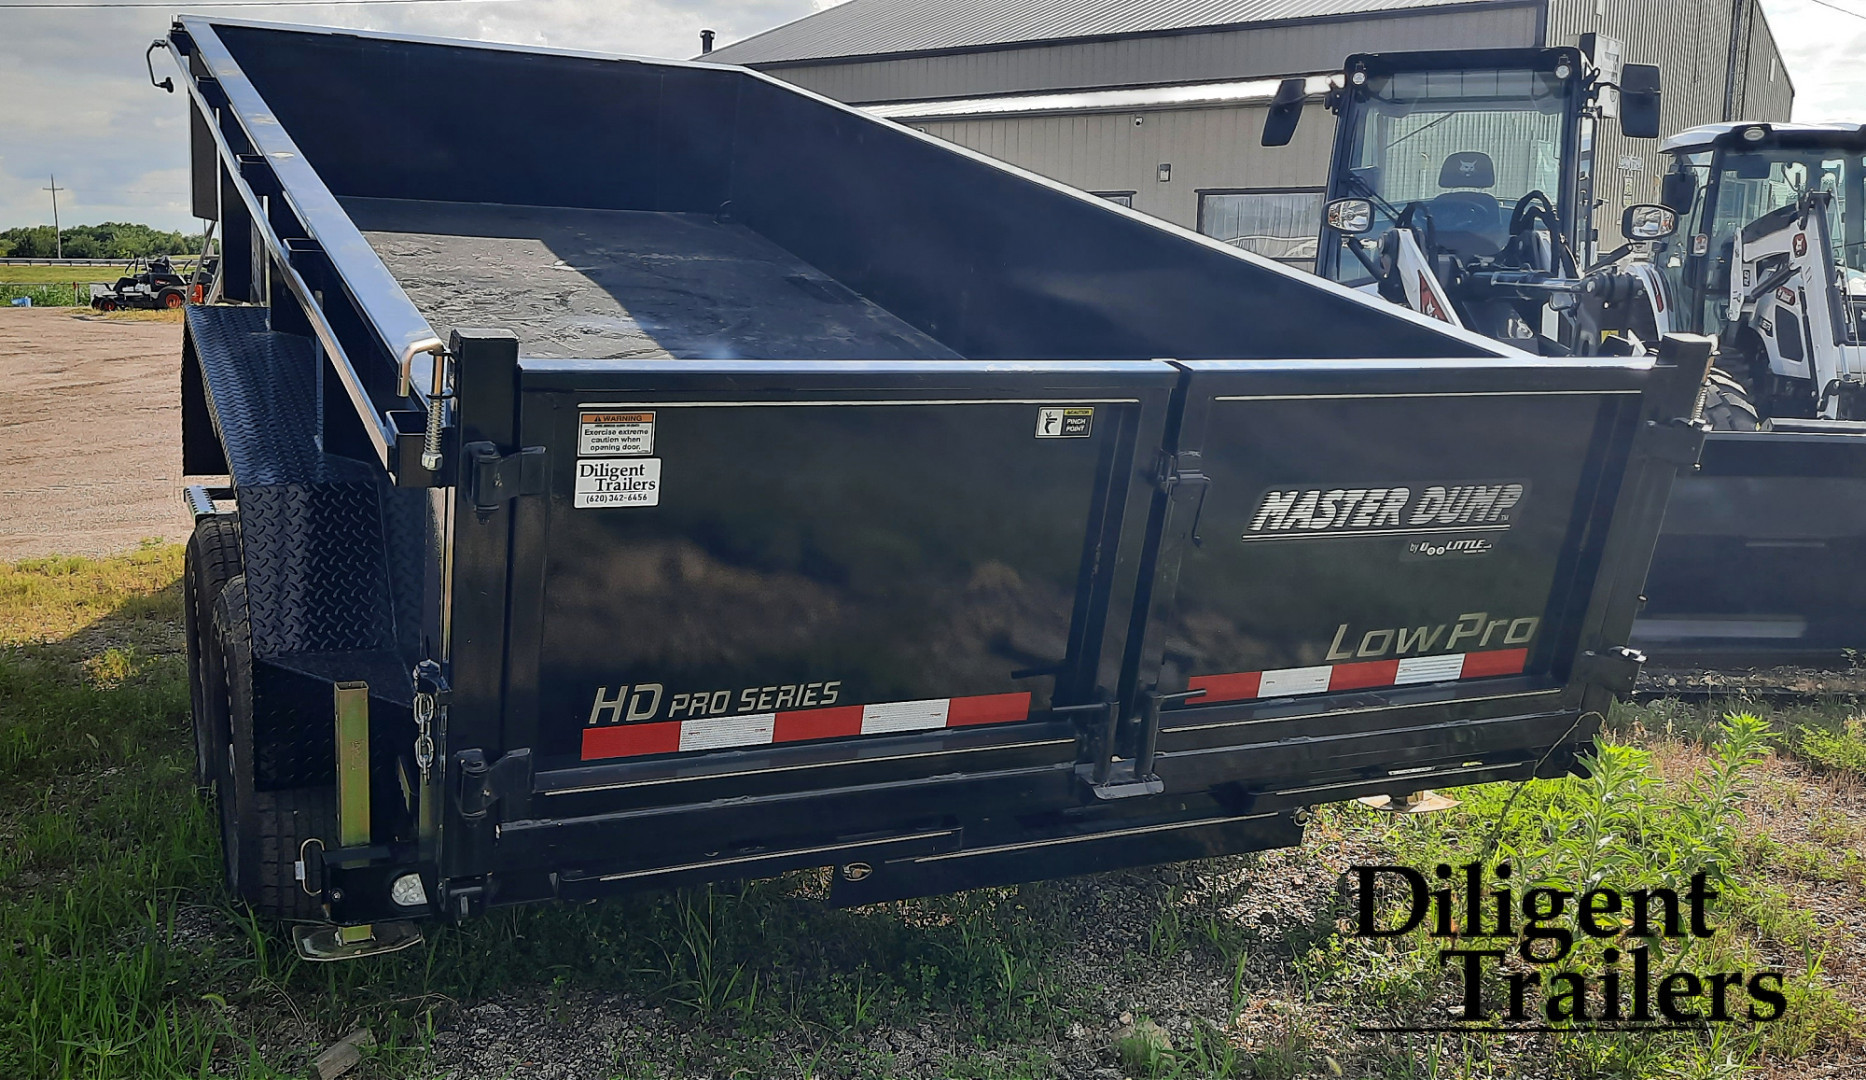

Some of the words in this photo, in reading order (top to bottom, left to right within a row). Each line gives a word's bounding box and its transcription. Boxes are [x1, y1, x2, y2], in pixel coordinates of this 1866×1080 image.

[584, 428, 617, 436] Exercise
[590, 444, 620, 452] opening
[580, 463, 645, 481] Diligent
[595, 477, 656, 491] Trailers
[586, 494, 608, 504] (620)
[1248, 486, 1411, 532] MASTER
[1406, 483, 1524, 526] DUMP
[1410, 543, 1419, 554] by
[588, 682, 664, 725] HD
[668, 690, 733, 718] PRO
[737, 680, 842, 712] SERIES
